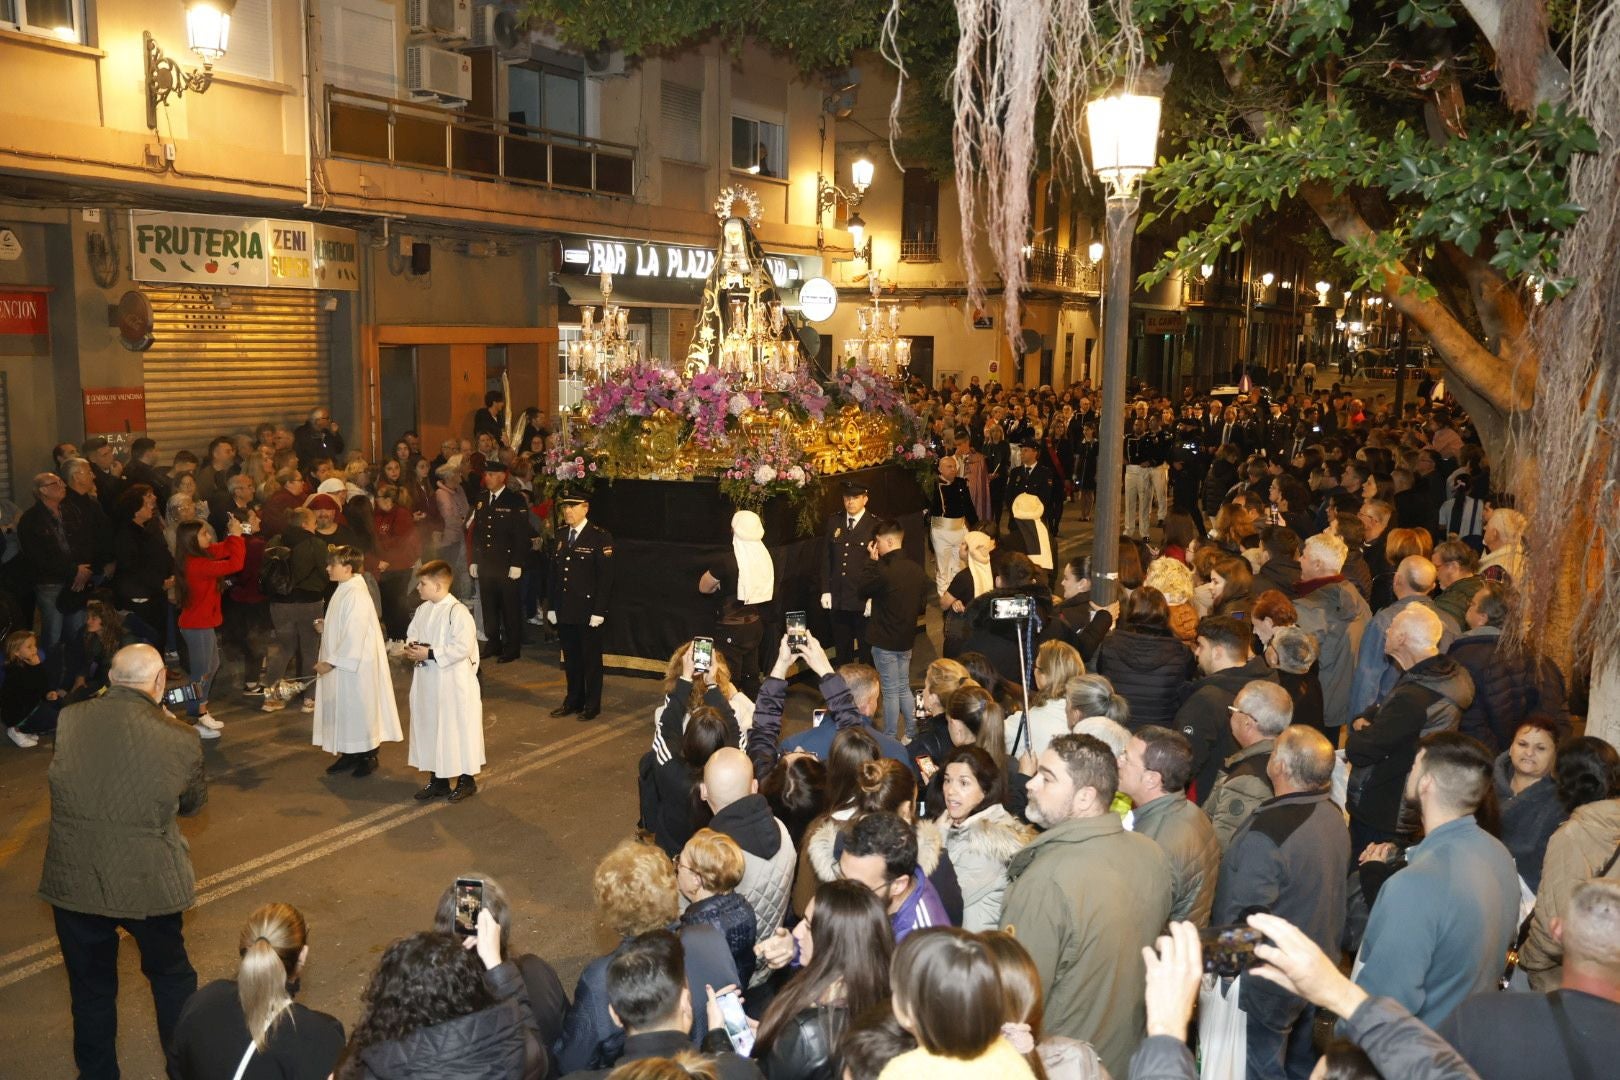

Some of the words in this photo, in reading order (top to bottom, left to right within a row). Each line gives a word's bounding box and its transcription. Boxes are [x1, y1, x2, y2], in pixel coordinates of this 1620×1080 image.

[136, 225, 263, 259] FRUTERIA
[273, 229, 306, 251] ZENI
[592, 243, 627, 274] BAR
[636, 246, 660, 277] LA
